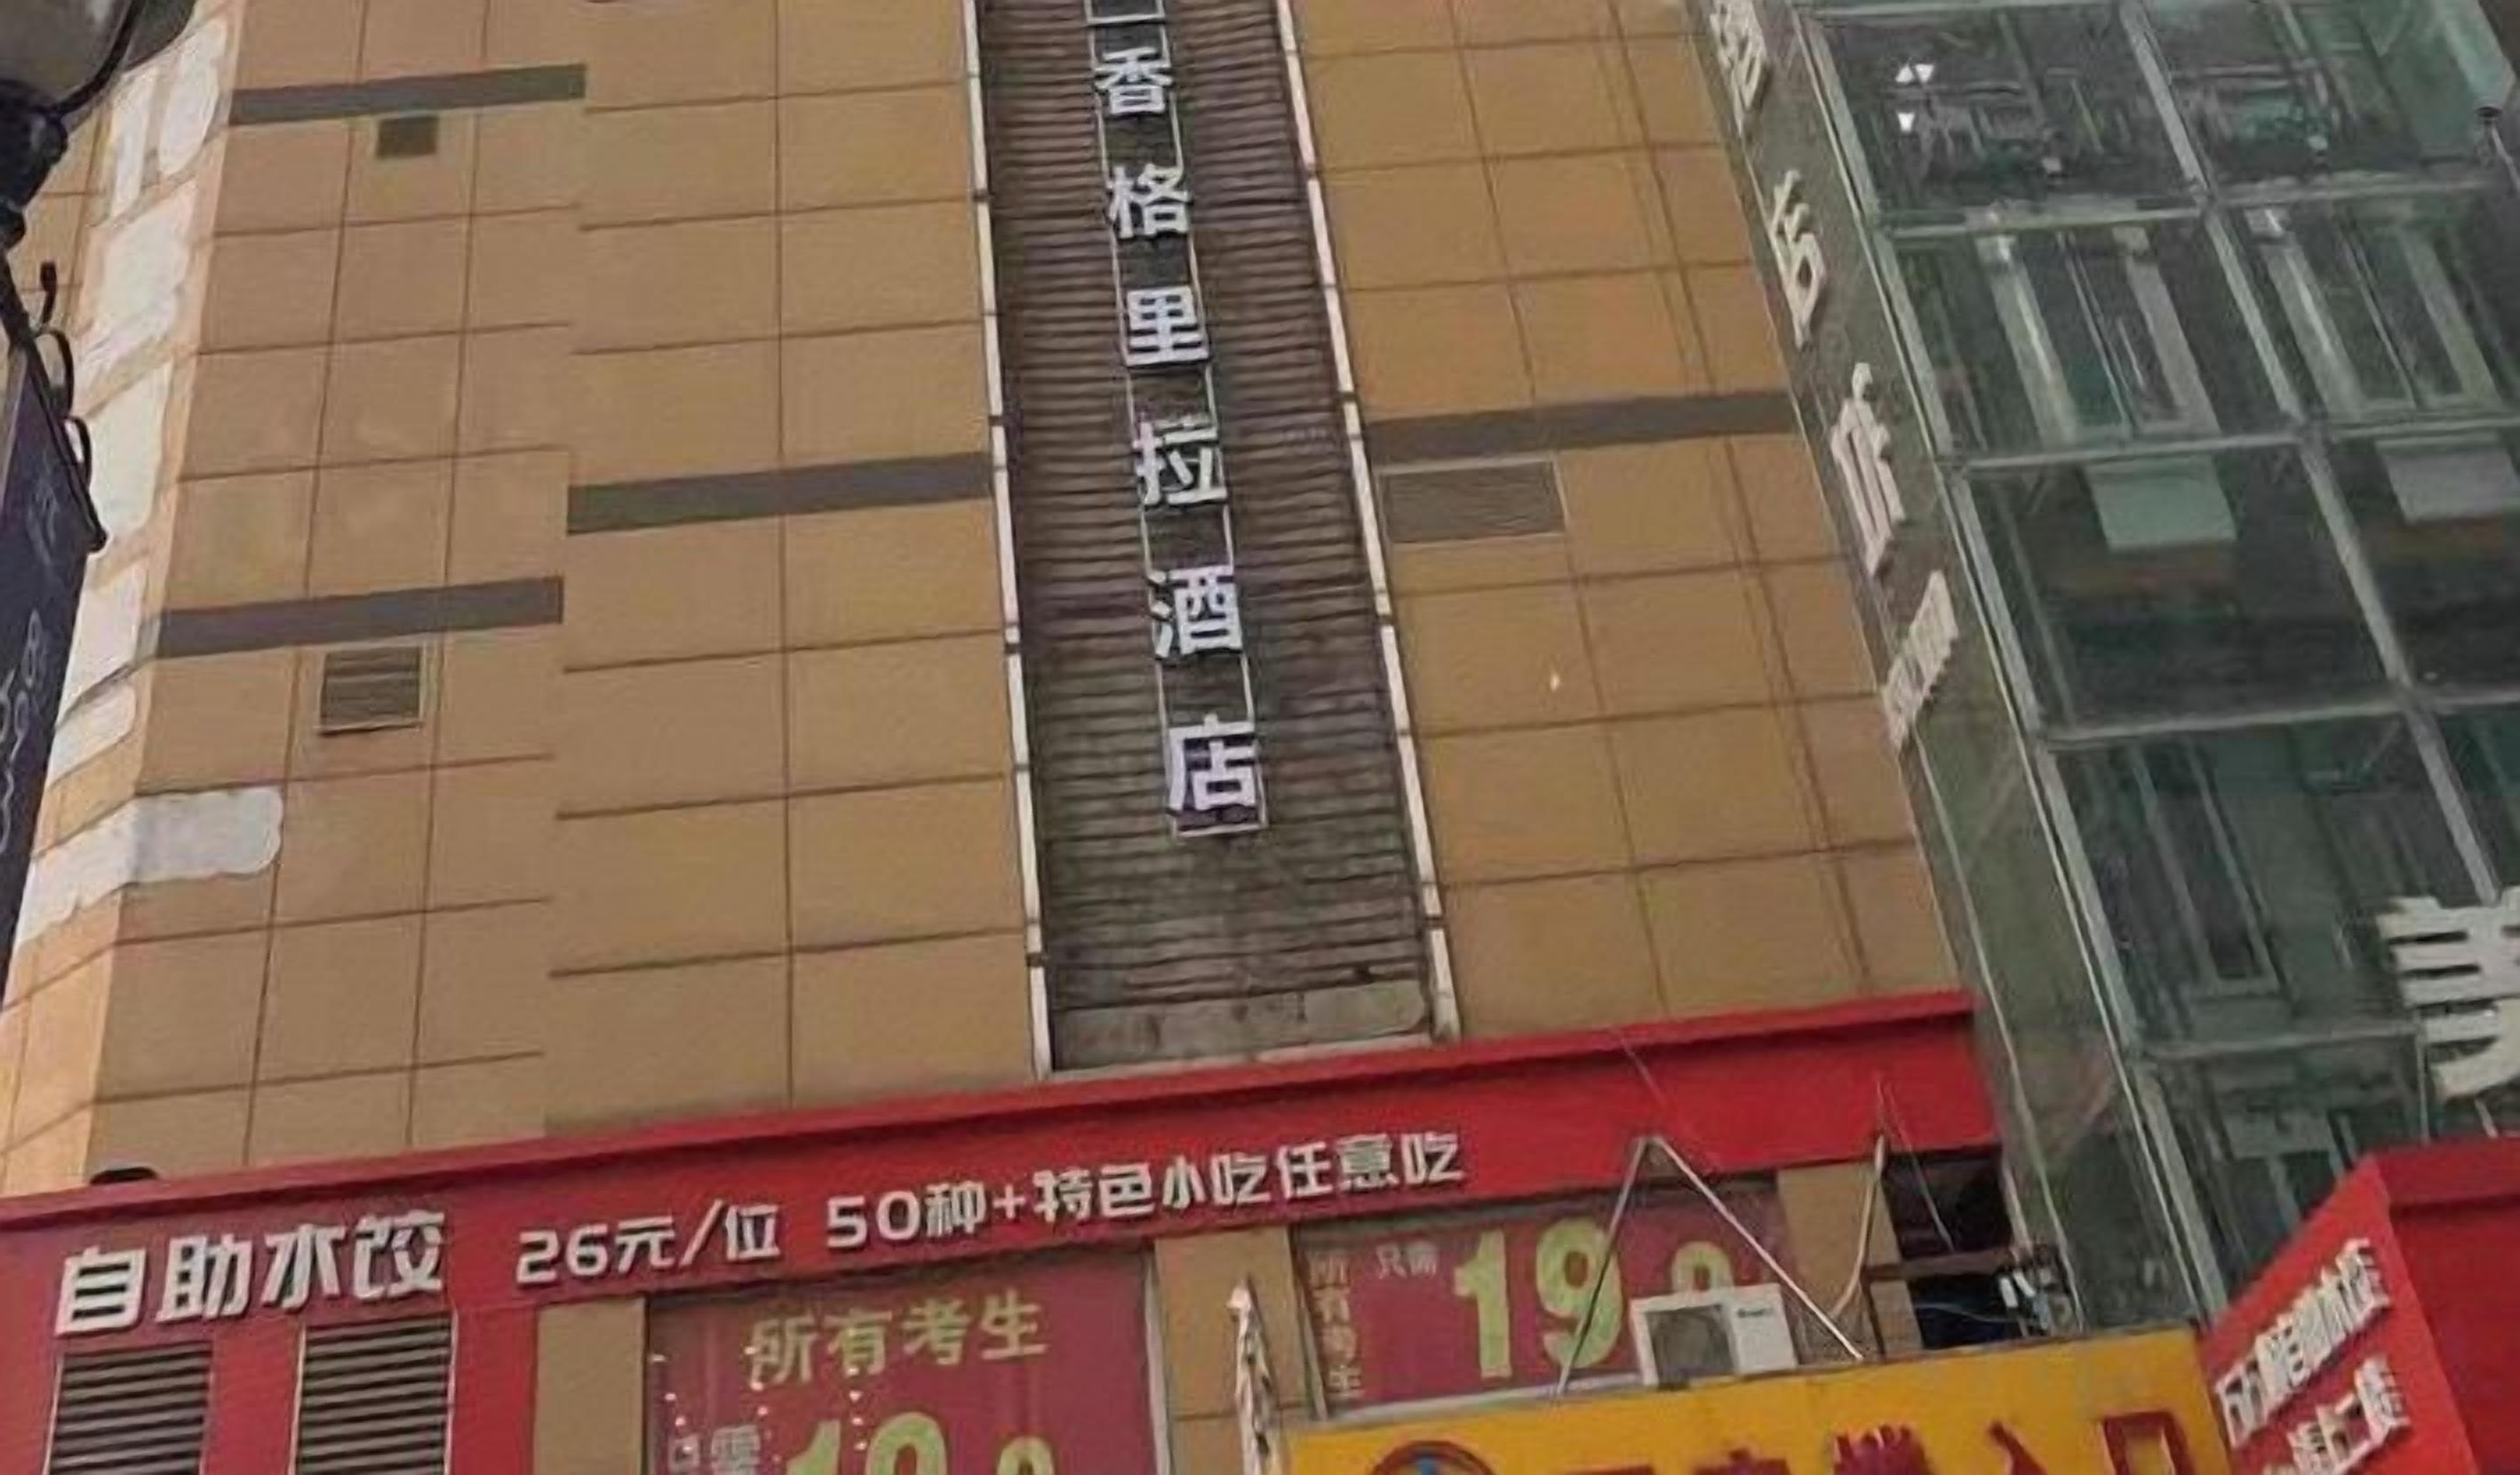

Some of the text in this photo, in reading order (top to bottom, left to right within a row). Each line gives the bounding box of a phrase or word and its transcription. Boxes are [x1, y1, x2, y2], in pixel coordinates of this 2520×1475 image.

[1091, 46, 1256, 810] 香格里拉酒店
[55, 1208, 446, 1336] 自助水饺
[516, 1132, 1464, 1284] 26元/位 50种+特色小吃任意吃
[749, 1288, 1049, 1389] 所有考生
